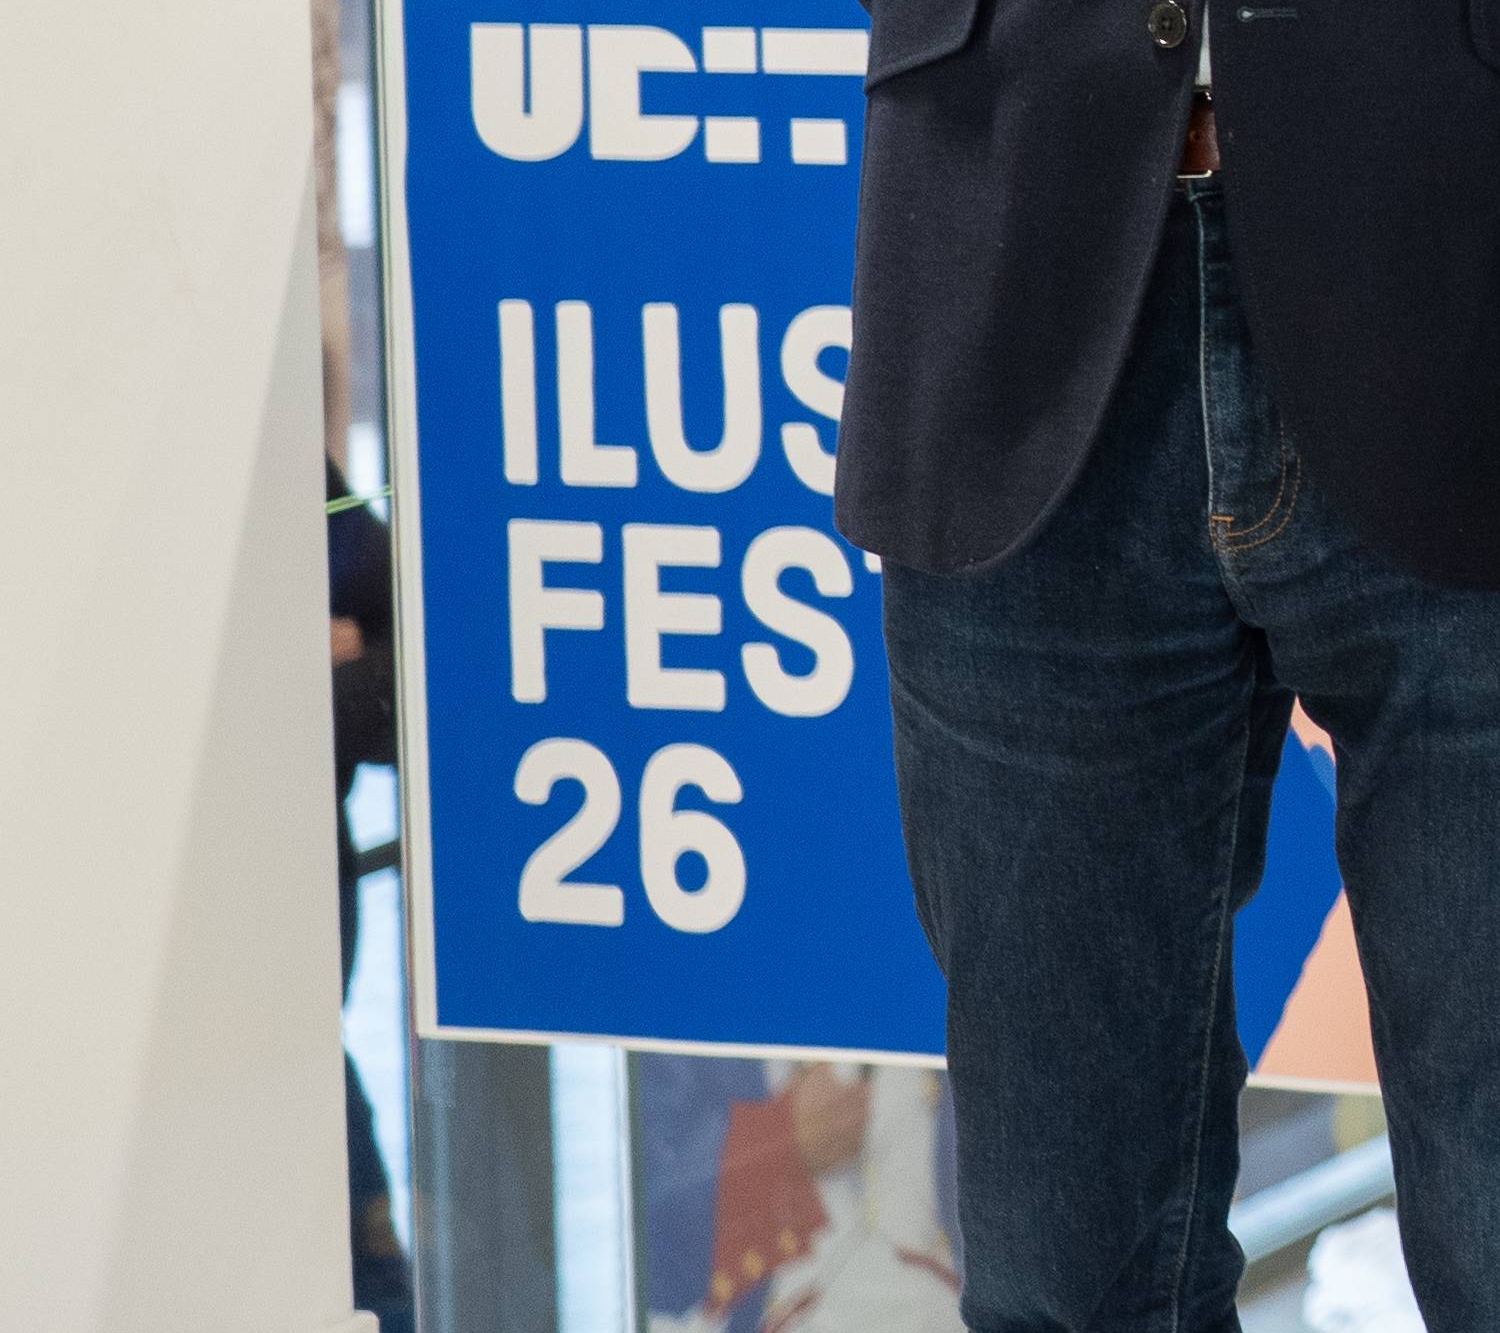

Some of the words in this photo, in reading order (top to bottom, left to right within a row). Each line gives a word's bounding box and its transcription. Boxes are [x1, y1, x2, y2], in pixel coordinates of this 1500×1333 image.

[497, 297, 854, 497] ILUS
[505, 517, 882, 718] FES
[512, 735, 748, 934] 26
